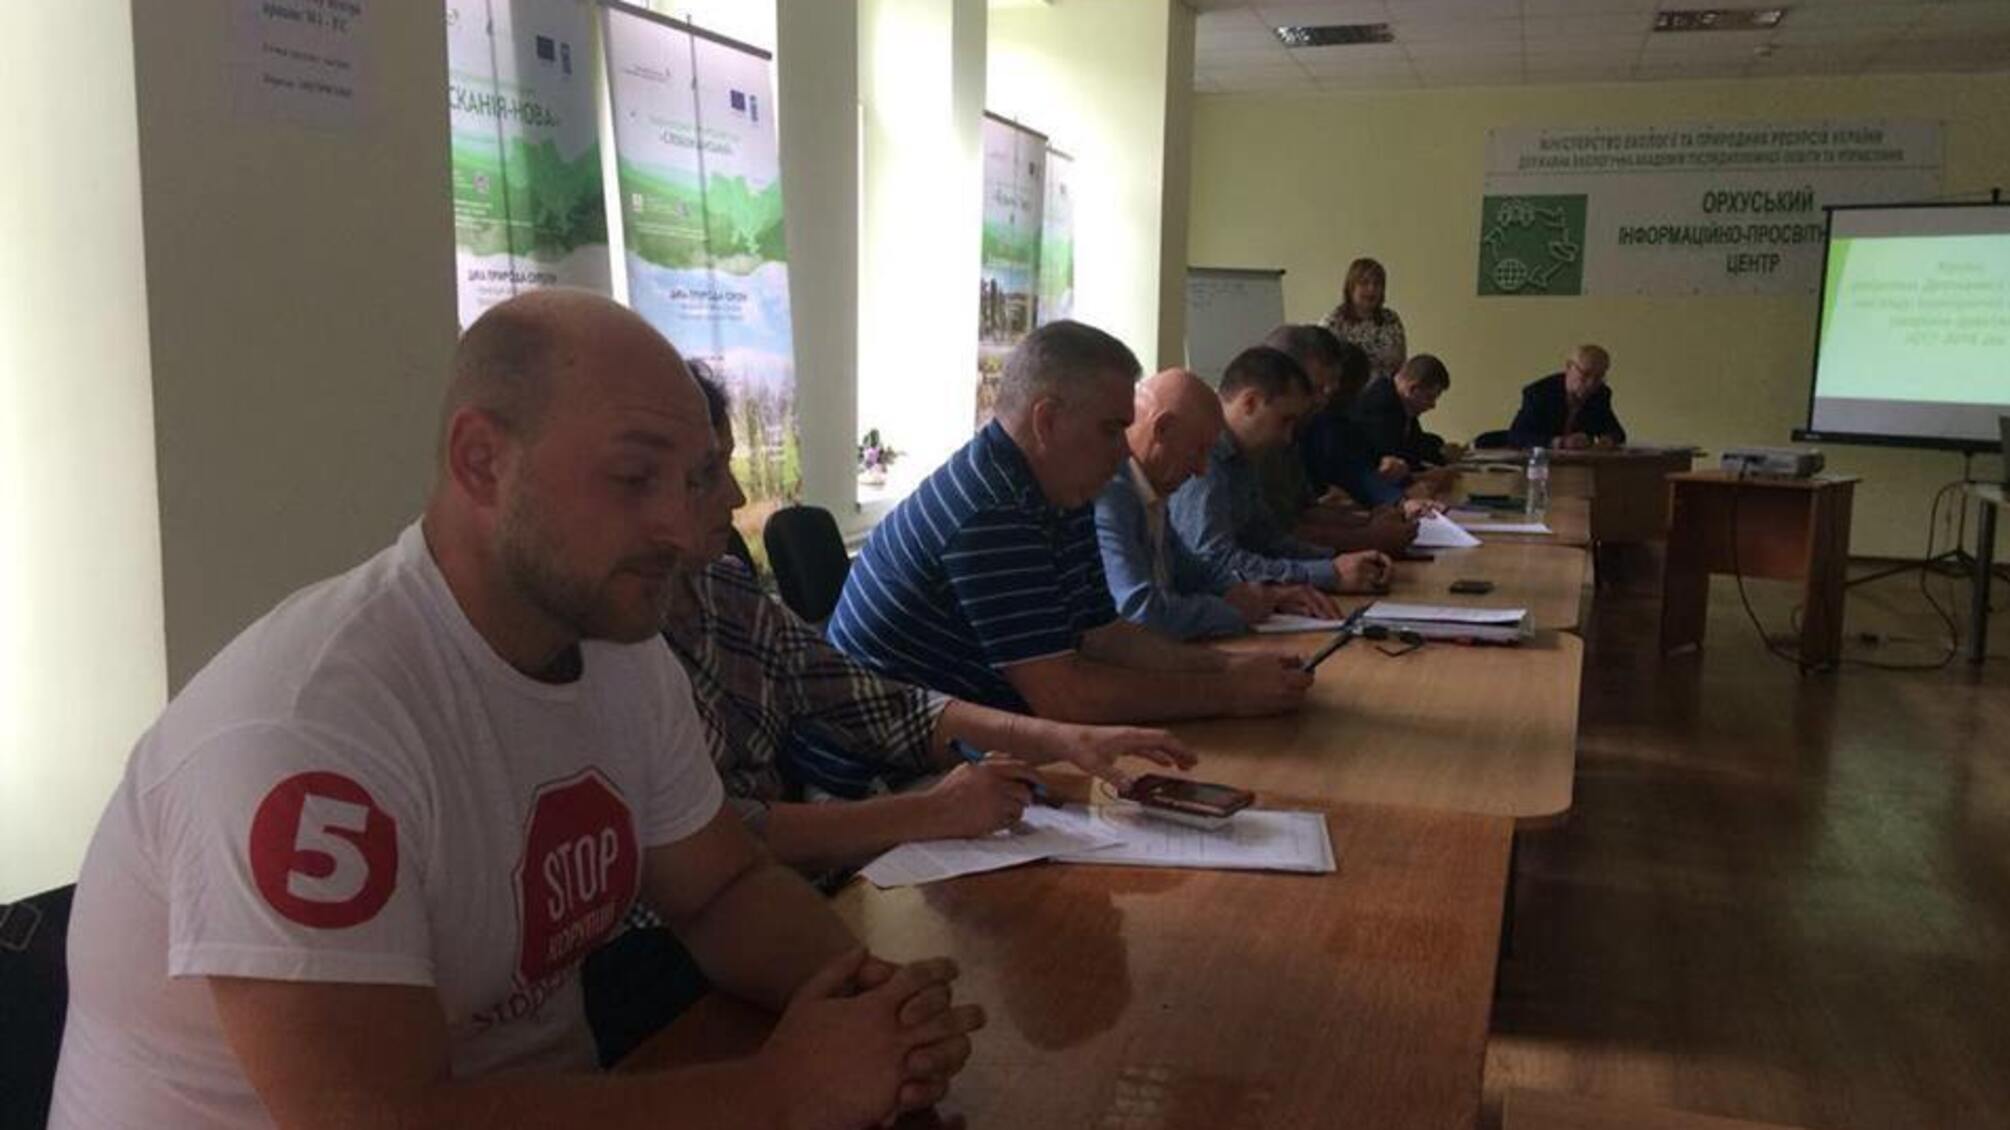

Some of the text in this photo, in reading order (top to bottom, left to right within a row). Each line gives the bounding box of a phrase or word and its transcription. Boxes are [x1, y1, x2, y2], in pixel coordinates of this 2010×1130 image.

[1702, 186, 1814, 215] ОРХУСЬКИЙ
[1726, 253, 1780, 276] ЦЕНТР
[286, 792, 371, 904] 5
[544, 826, 618, 921] STOP
